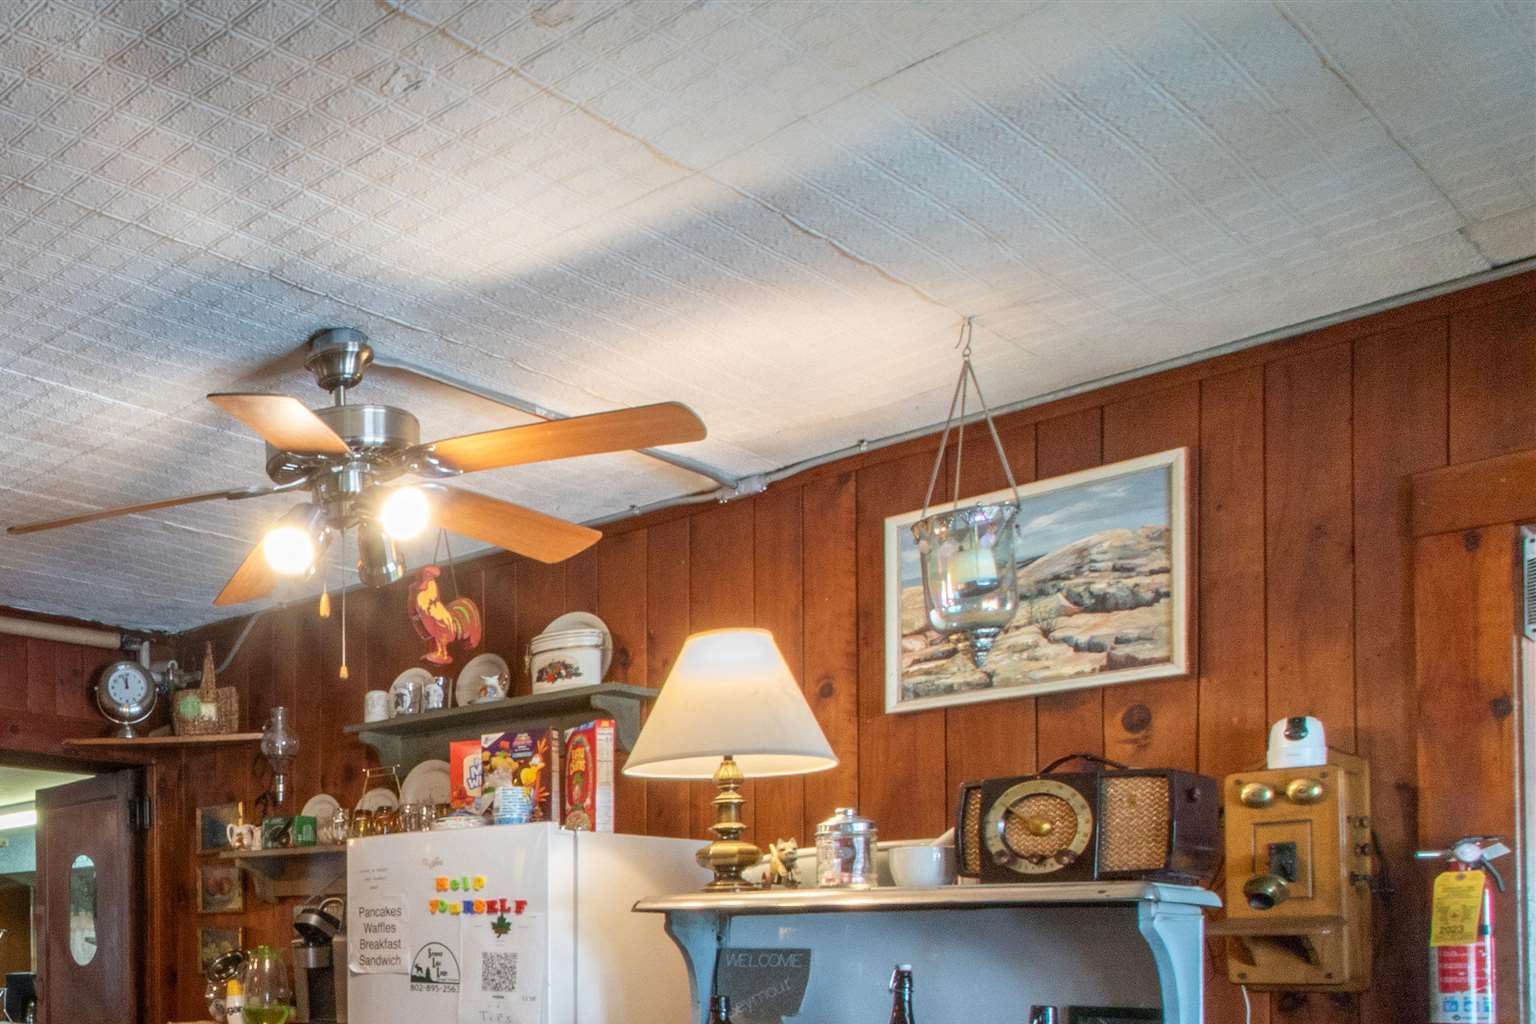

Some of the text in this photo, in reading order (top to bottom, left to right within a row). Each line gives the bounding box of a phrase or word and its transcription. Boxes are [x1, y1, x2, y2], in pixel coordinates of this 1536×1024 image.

[359, 906, 402, 918] Pancakes
[364, 922, 397, 934] Waffles
[360, 938, 401, 951] Breakfast
[359, 954, 401, 967] Sandwich
[726, 952, 802, 969] WELCOME
